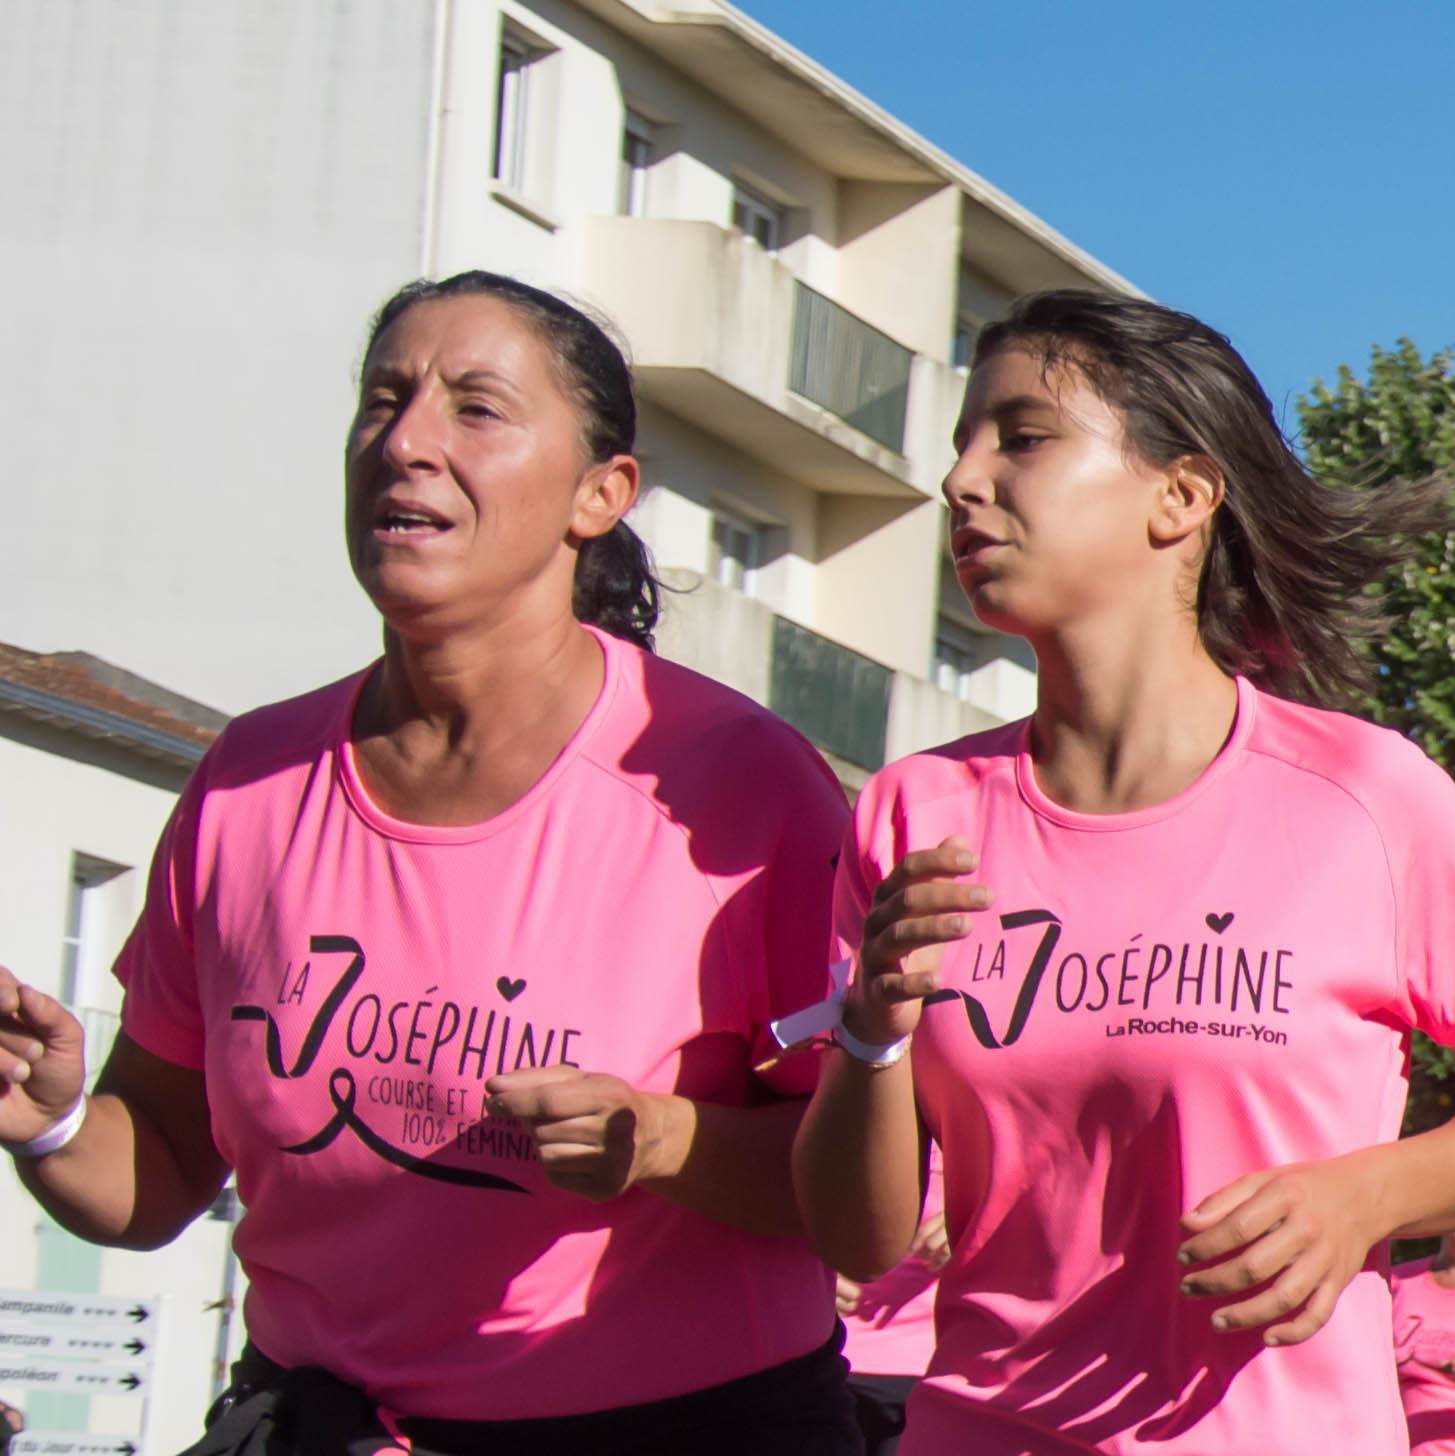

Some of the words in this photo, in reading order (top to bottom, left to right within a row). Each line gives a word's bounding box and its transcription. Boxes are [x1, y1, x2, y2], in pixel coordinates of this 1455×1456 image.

[972, 939, 1006, 982] LA
[277, 961, 311, 1006] LA
[1106, 1024, 1125, 1037] La
[1128, 1018, 1288, 1046] Roche-sur-Yon
[368, 1076, 434, 1113] COURSE
[447, 1088, 468, 1116] ET
[457, 1119, 537, 1161] FÉMINI
